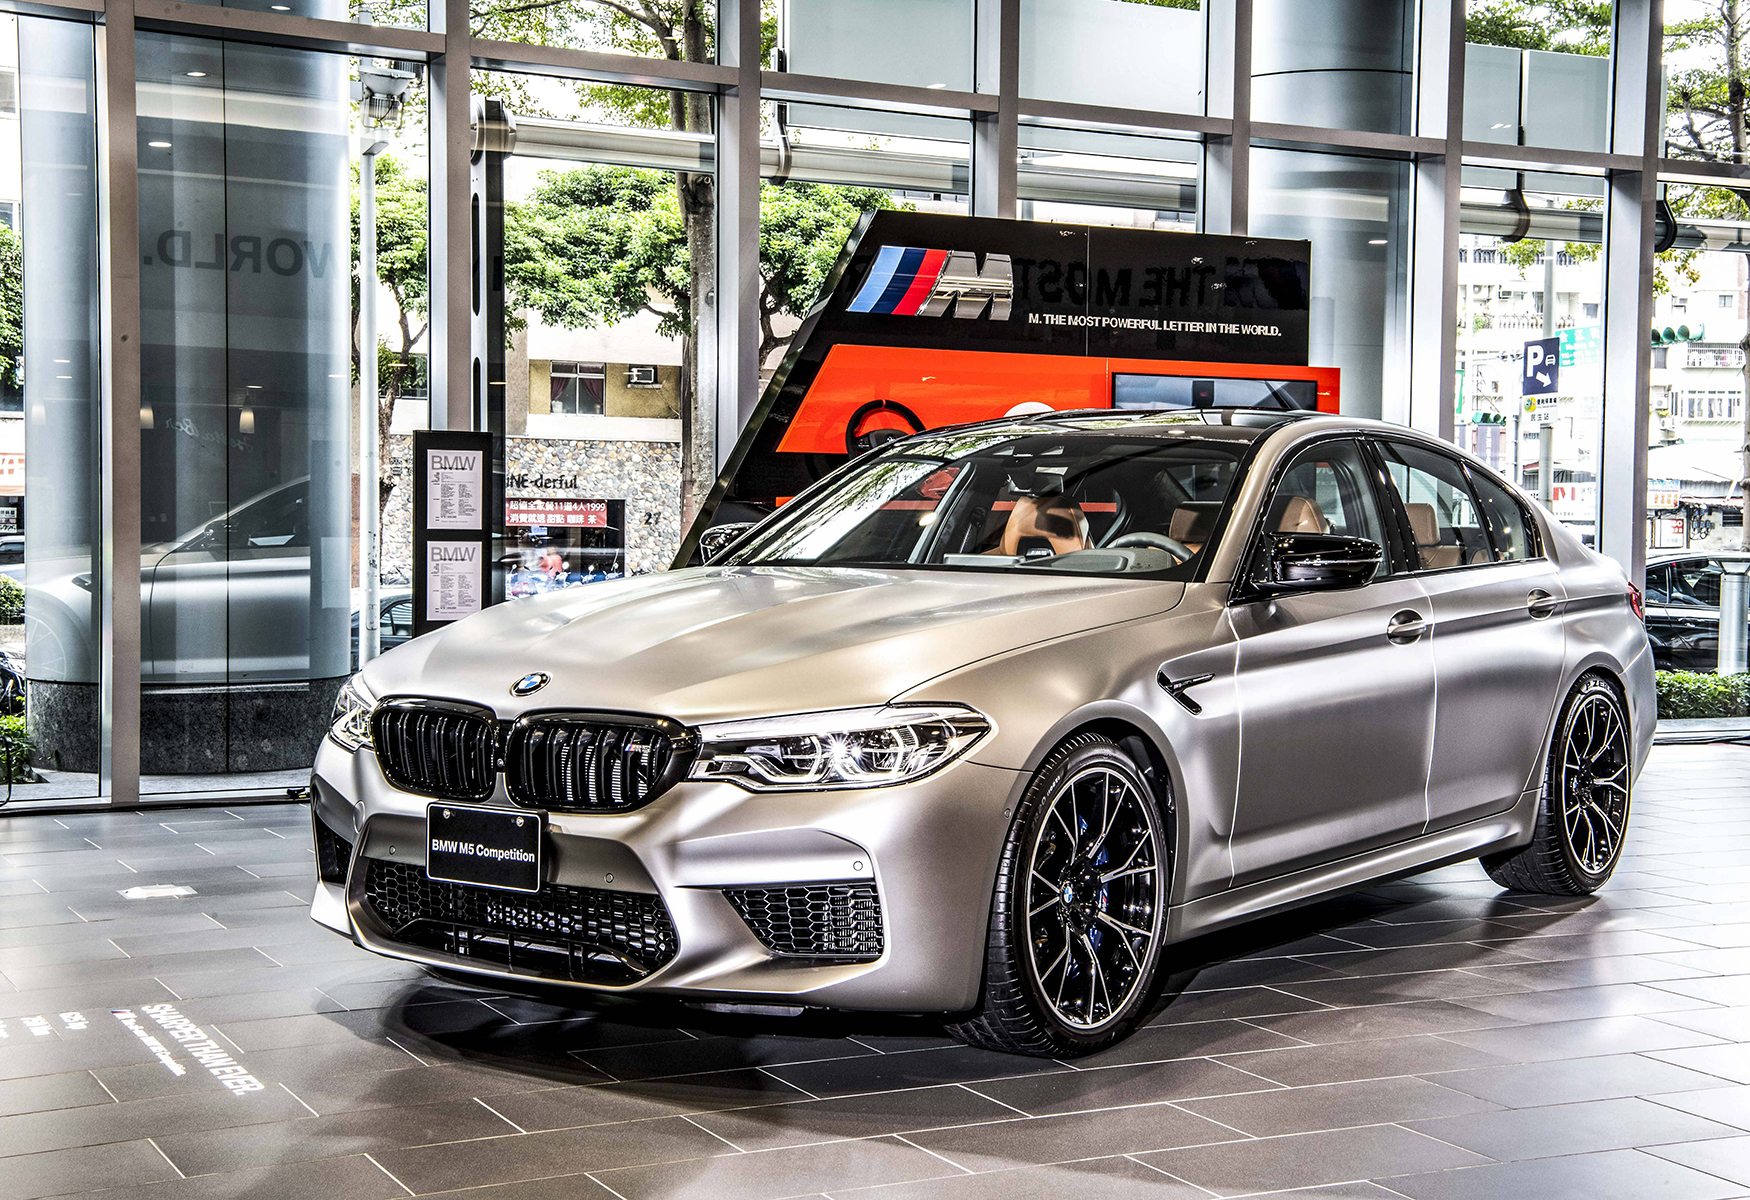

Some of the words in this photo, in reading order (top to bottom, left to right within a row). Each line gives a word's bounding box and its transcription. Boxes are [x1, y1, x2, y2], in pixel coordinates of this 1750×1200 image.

[1028, 312, 1042, 324] M.
[1043, 313, 1067, 326] THE
[1067, 315, 1102, 327] MOST
[1102, 317, 1162, 330] POWERFUL
[1163, 320, 1205, 333] LETTER
[1205, 322, 1217, 333] IN
[1218, 323, 1240, 334] THE
[1241, 324, 1282, 337] WORLD.
[1526, 344, 1544, 378] P
[431, 455, 476, 471] BMW
[431, 546, 476, 562] BMW
[432, 839, 458, 853] BMW
[459, 842, 475, 856] M5
[475, 844, 536, 863] Competition
[141, 1003, 208, 1043] SHARPER
[183, 1039, 238, 1068] THAN
[209, 1065, 265, 1096] EVER.
